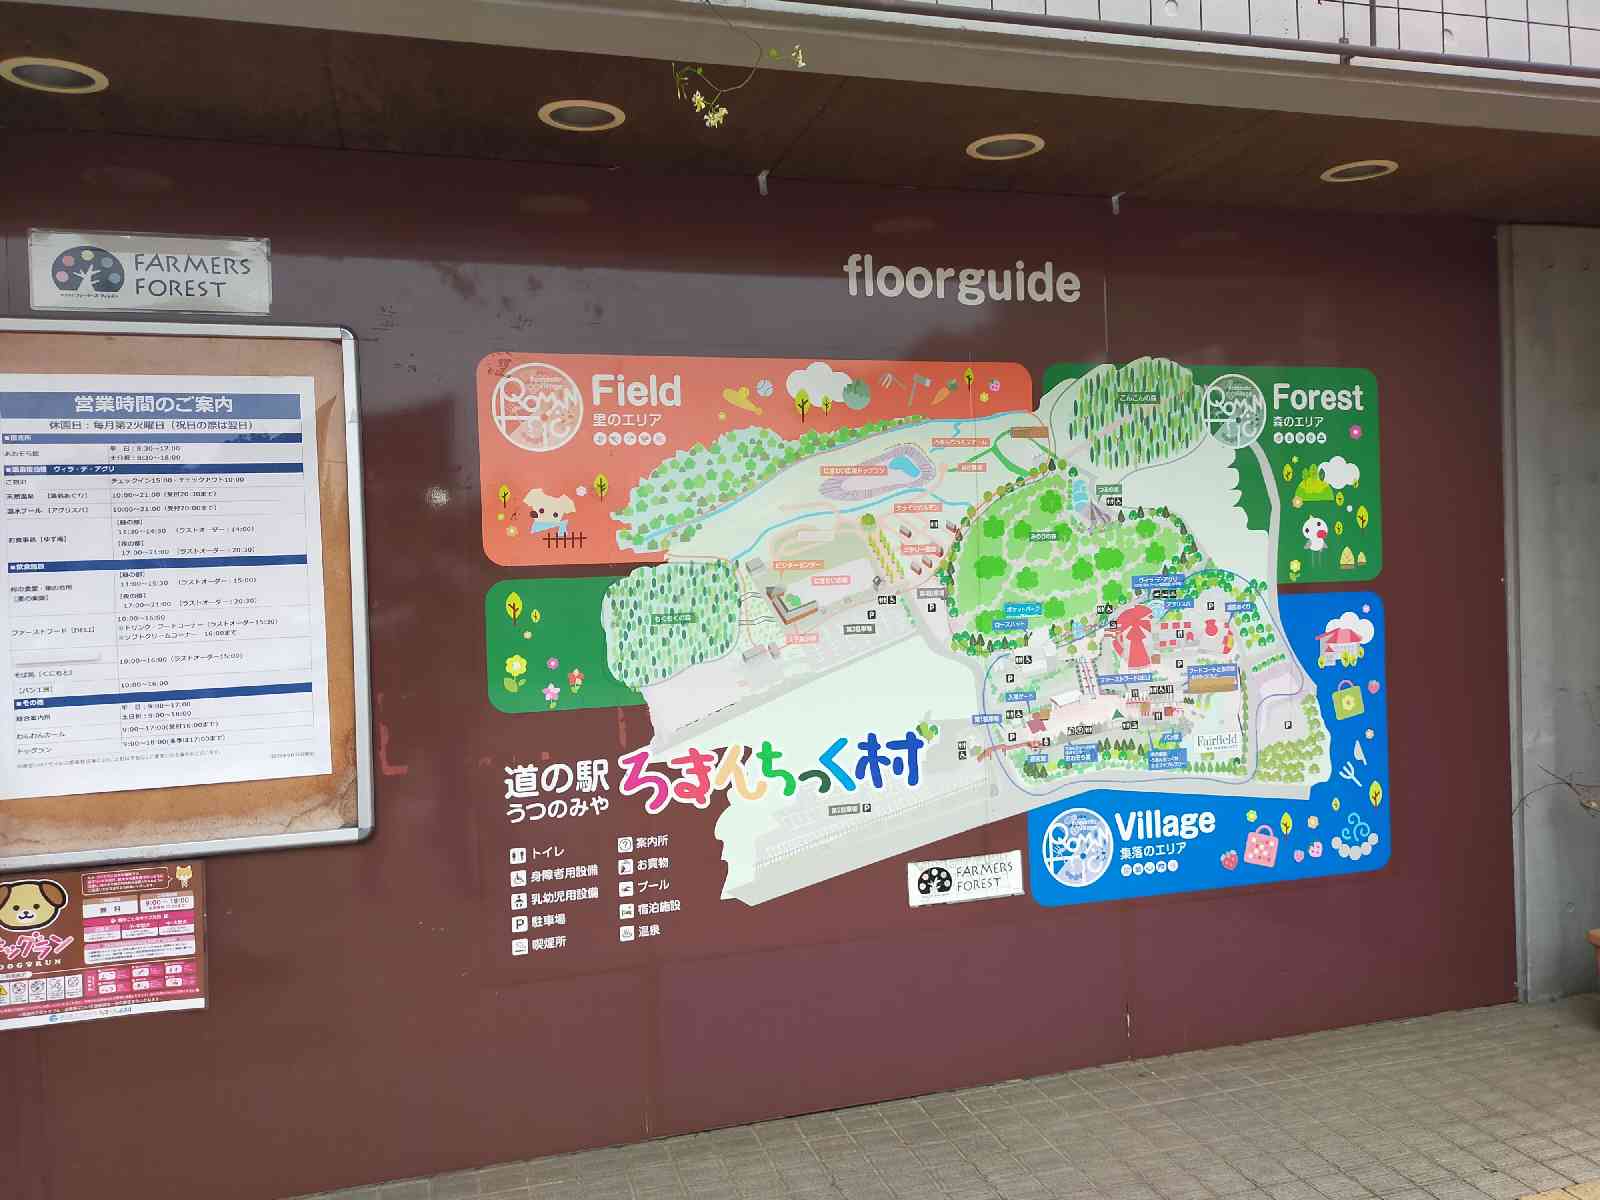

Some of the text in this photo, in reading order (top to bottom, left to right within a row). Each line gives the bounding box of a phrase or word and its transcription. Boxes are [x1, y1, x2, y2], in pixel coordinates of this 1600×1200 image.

[134, 253, 251, 275] FARMERS
[843, 253, 1081, 305] floorguide
[135, 278, 226, 298] FOREST
[592, 374, 682, 407] Field
[1273, 383, 1364, 411] Forest
[74, 395, 234, 414] 営業時間のご案内
[592, 413, 662, 427] 里のエリア
[1273, 416, 1324, 428] 森のエリア
[1197, 734, 1237, 747] Fairfield
[504, 758, 610, 799] 道の駅
[621, 731, 925, 814] ろまんちっく村
[506, 795, 609, 823] うつのみや
[1115, 809, 1216, 841] Village
[636, 834, 668, 849] 案内所
[532, 846, 565, 860] トイレ
[1119, 841, 1186, 860] 集落のエリア
[637, 857, 668, 871] お買物
[956, 860, 1014, 877] FARMERS
[638, 879, 669, 893] プール
[957, 876, 1001, 892] FOREST
[530, 887, 599, 905] 乳幼児用設備
[638, 900, 681, 916] 宿泊施設
[531, 913, 566, 928] 駐車場
[639, 924, 661, 938] 温泉
[532, 936, 567, 951] 喫煙所
